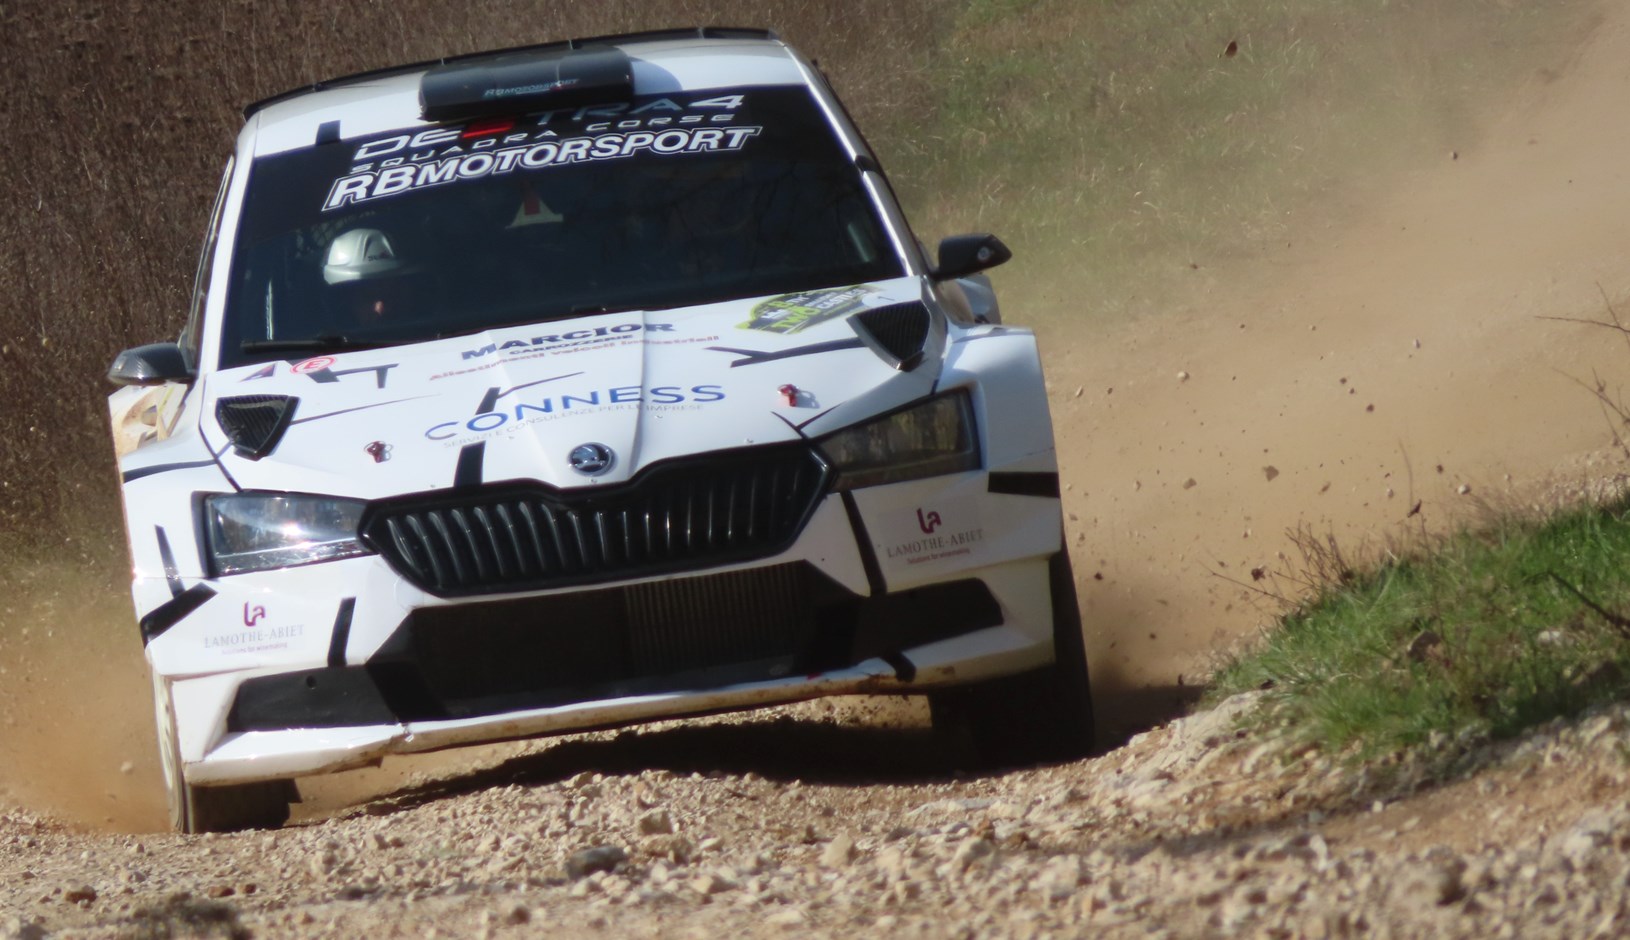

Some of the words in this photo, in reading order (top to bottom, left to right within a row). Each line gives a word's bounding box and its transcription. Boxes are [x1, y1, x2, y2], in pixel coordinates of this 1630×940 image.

[350, 129, 558, 174] SQUADRA
[586, 113, 735, 132] CORSE
[321, 126, 763, 212] RBMOTORSPORT
[461, 323, 676, 360] MARCIOR
[425, 385, 726, 440] CONNESS
[887, 528, 983, 558] LAMOTHE-ABIET
[204, 624, 304, 649] LAMOTHE-ABIET
